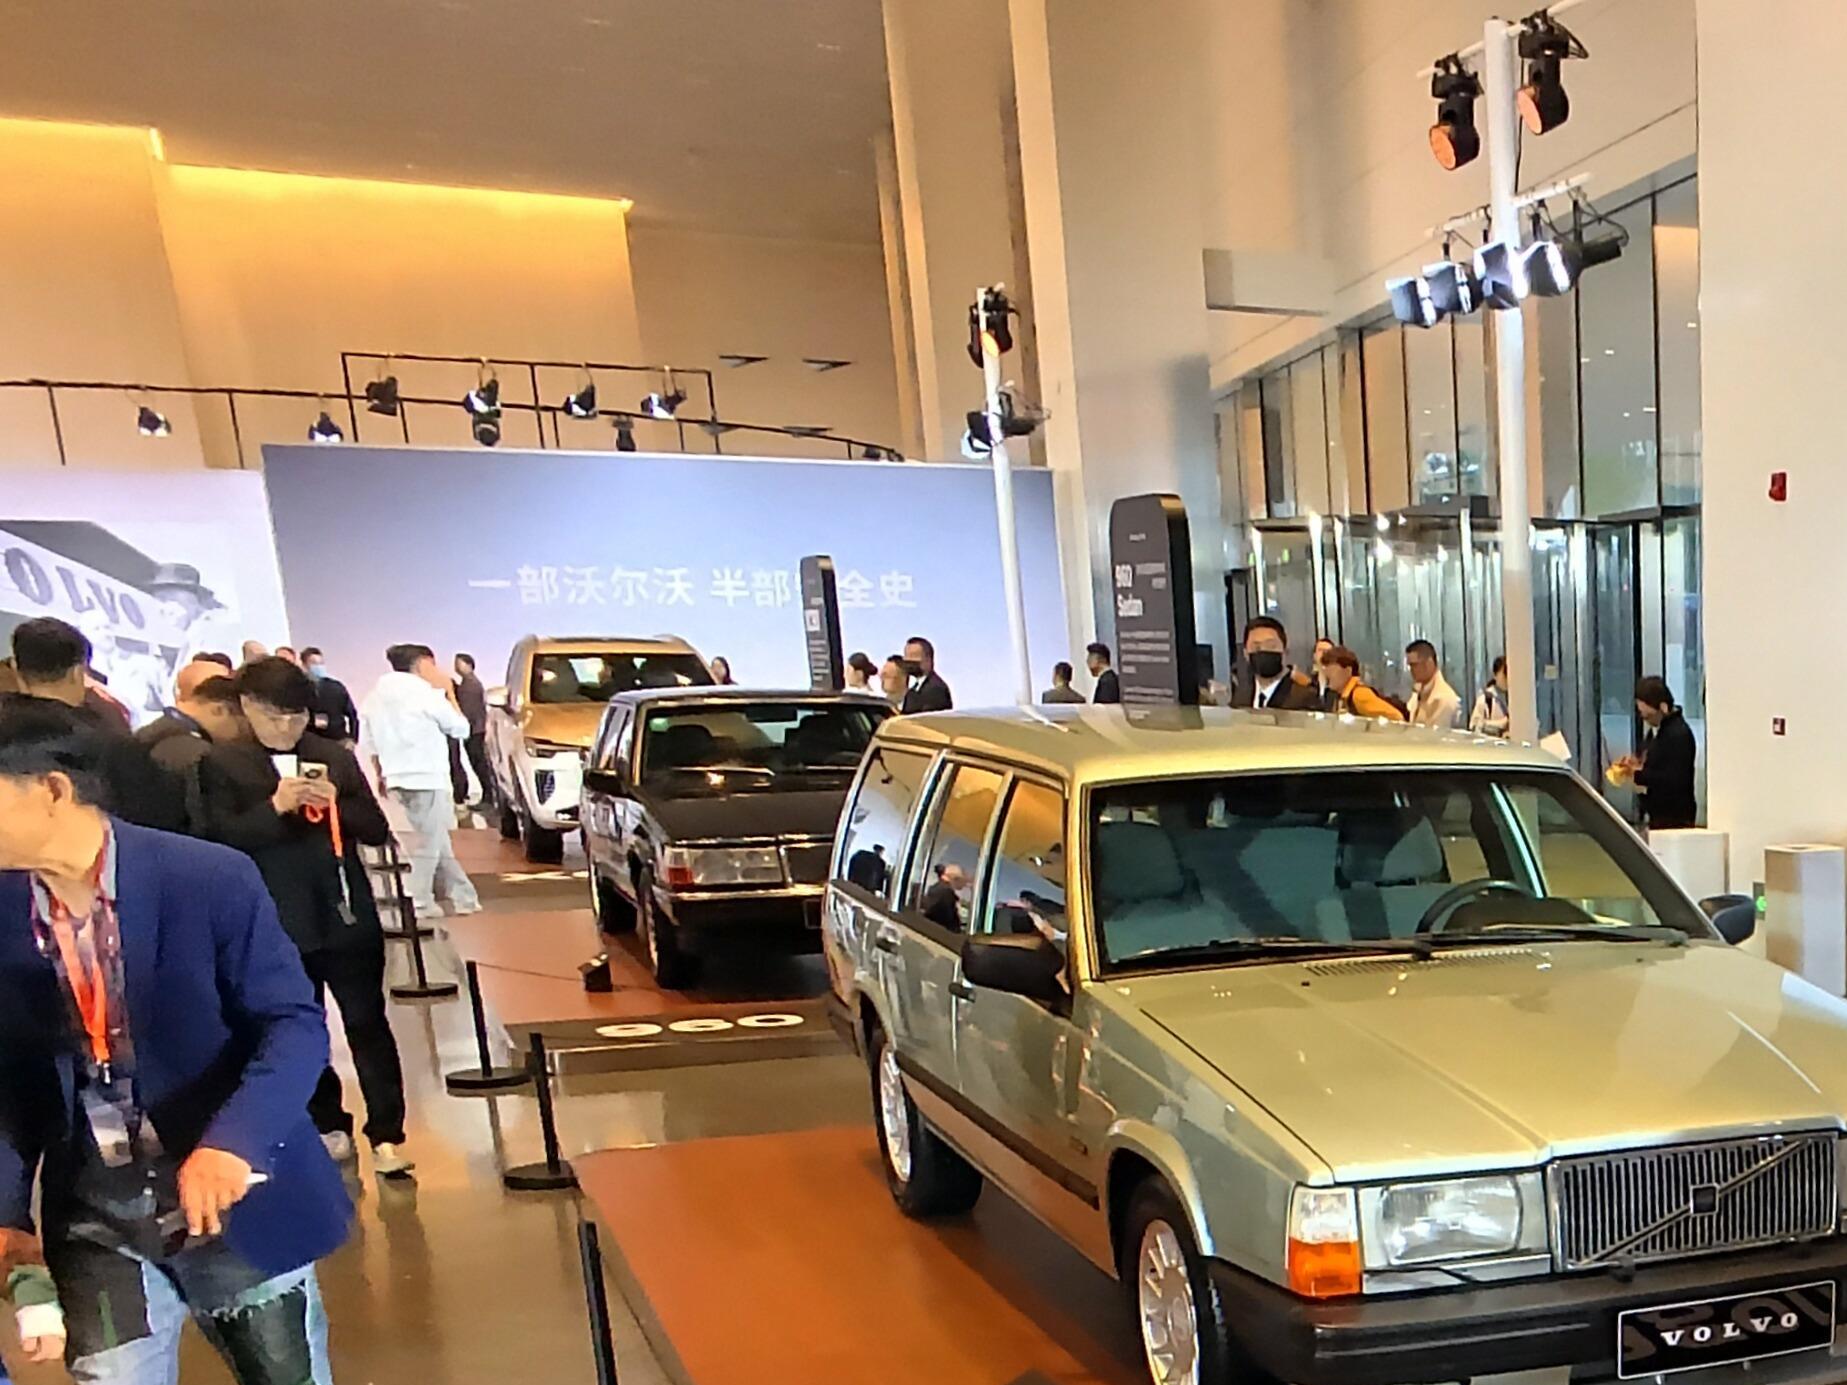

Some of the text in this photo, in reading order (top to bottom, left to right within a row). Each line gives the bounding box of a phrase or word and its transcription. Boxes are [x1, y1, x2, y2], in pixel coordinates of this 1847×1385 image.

[468, 564, 917, 608] 一部沃尔沃 半部全史
[1660, 1312, 1799, 1347] VOLVO
